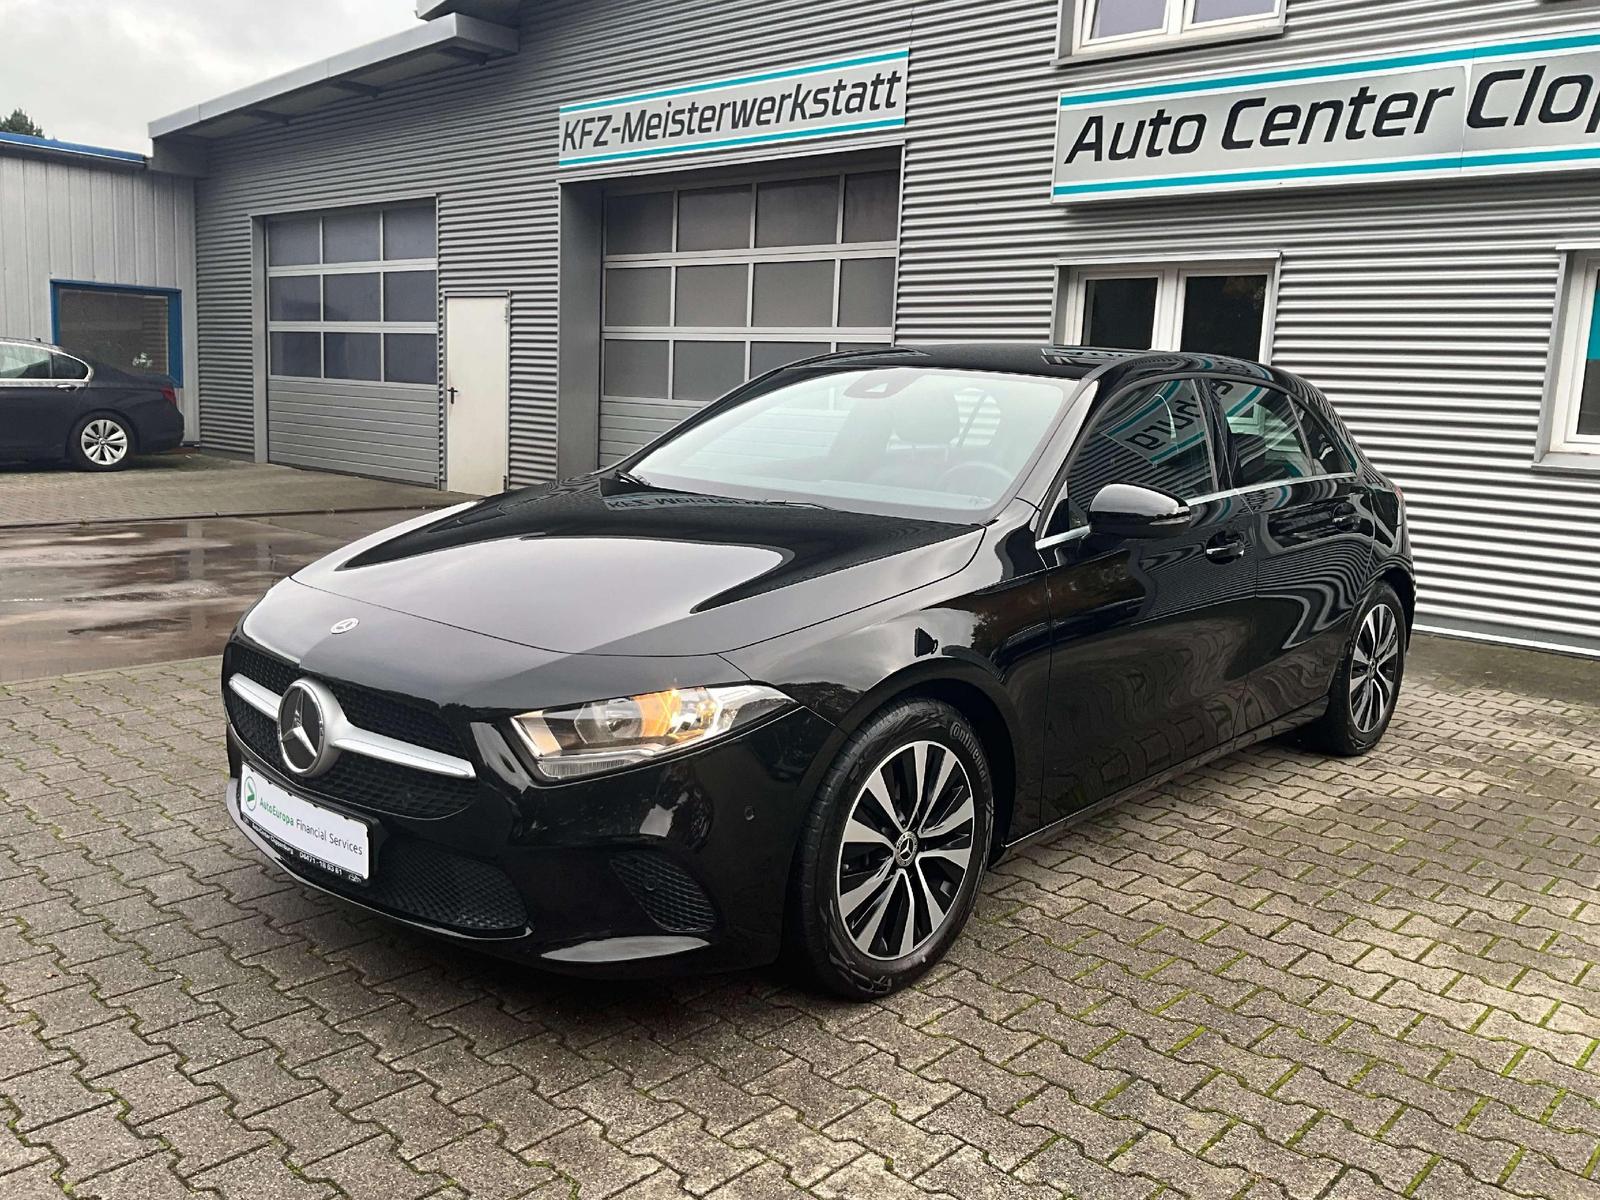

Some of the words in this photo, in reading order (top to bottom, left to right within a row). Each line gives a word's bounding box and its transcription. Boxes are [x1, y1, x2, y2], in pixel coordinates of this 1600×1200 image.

[562, 70, 902, 151] KFZ-Meisterwerkstatt
[1064, 108, 1207, 164] Auto
[1220, 85, 1455, 150] Center
[259, 797, 295, 827] AutoEuropa
[296, 818, 327, 841] Financial
[329, 833, 363, 856] Services
